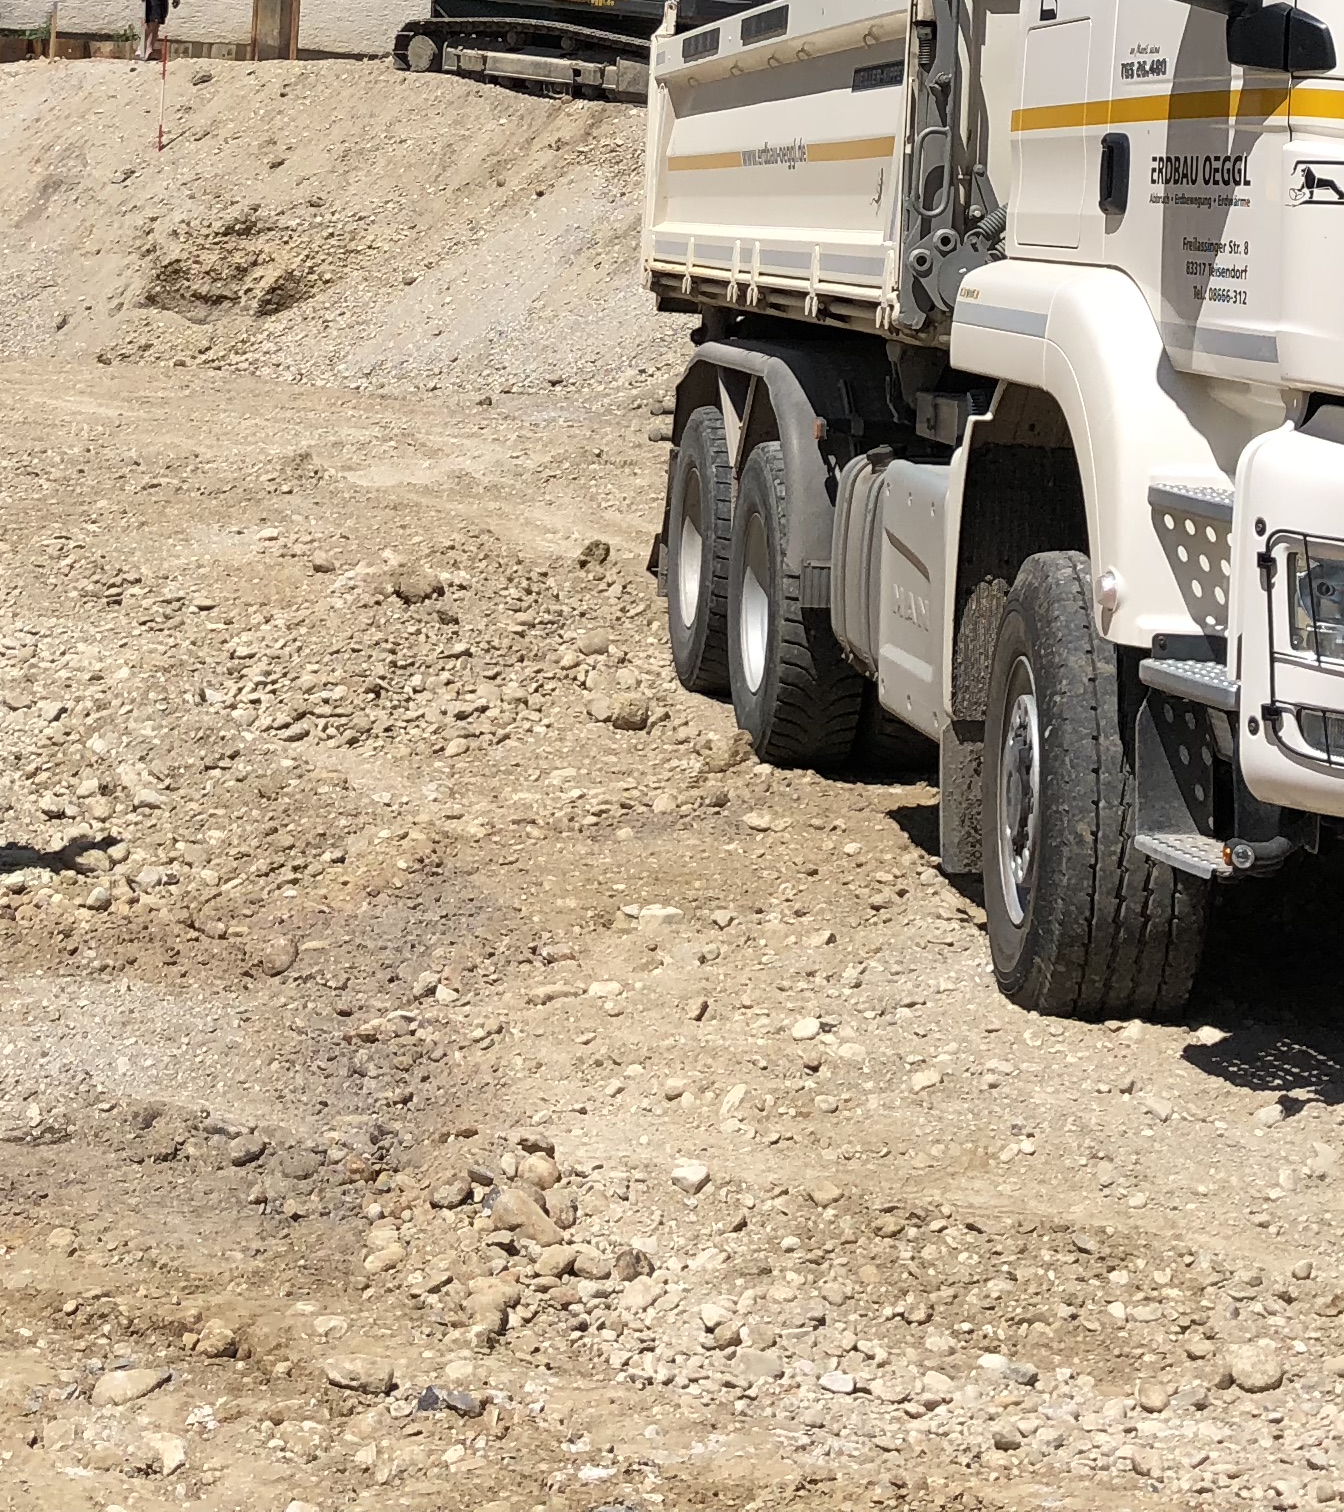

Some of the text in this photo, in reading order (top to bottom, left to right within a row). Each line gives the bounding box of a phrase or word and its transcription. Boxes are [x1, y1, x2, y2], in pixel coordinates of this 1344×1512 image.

[1150, 155, 1251, 187] ERDBAU OEGGL
[1182, 236, 1249, 257] Freilassinger Str. 8
[1185, 260, 1248, 281] 83317 Teisendorf
